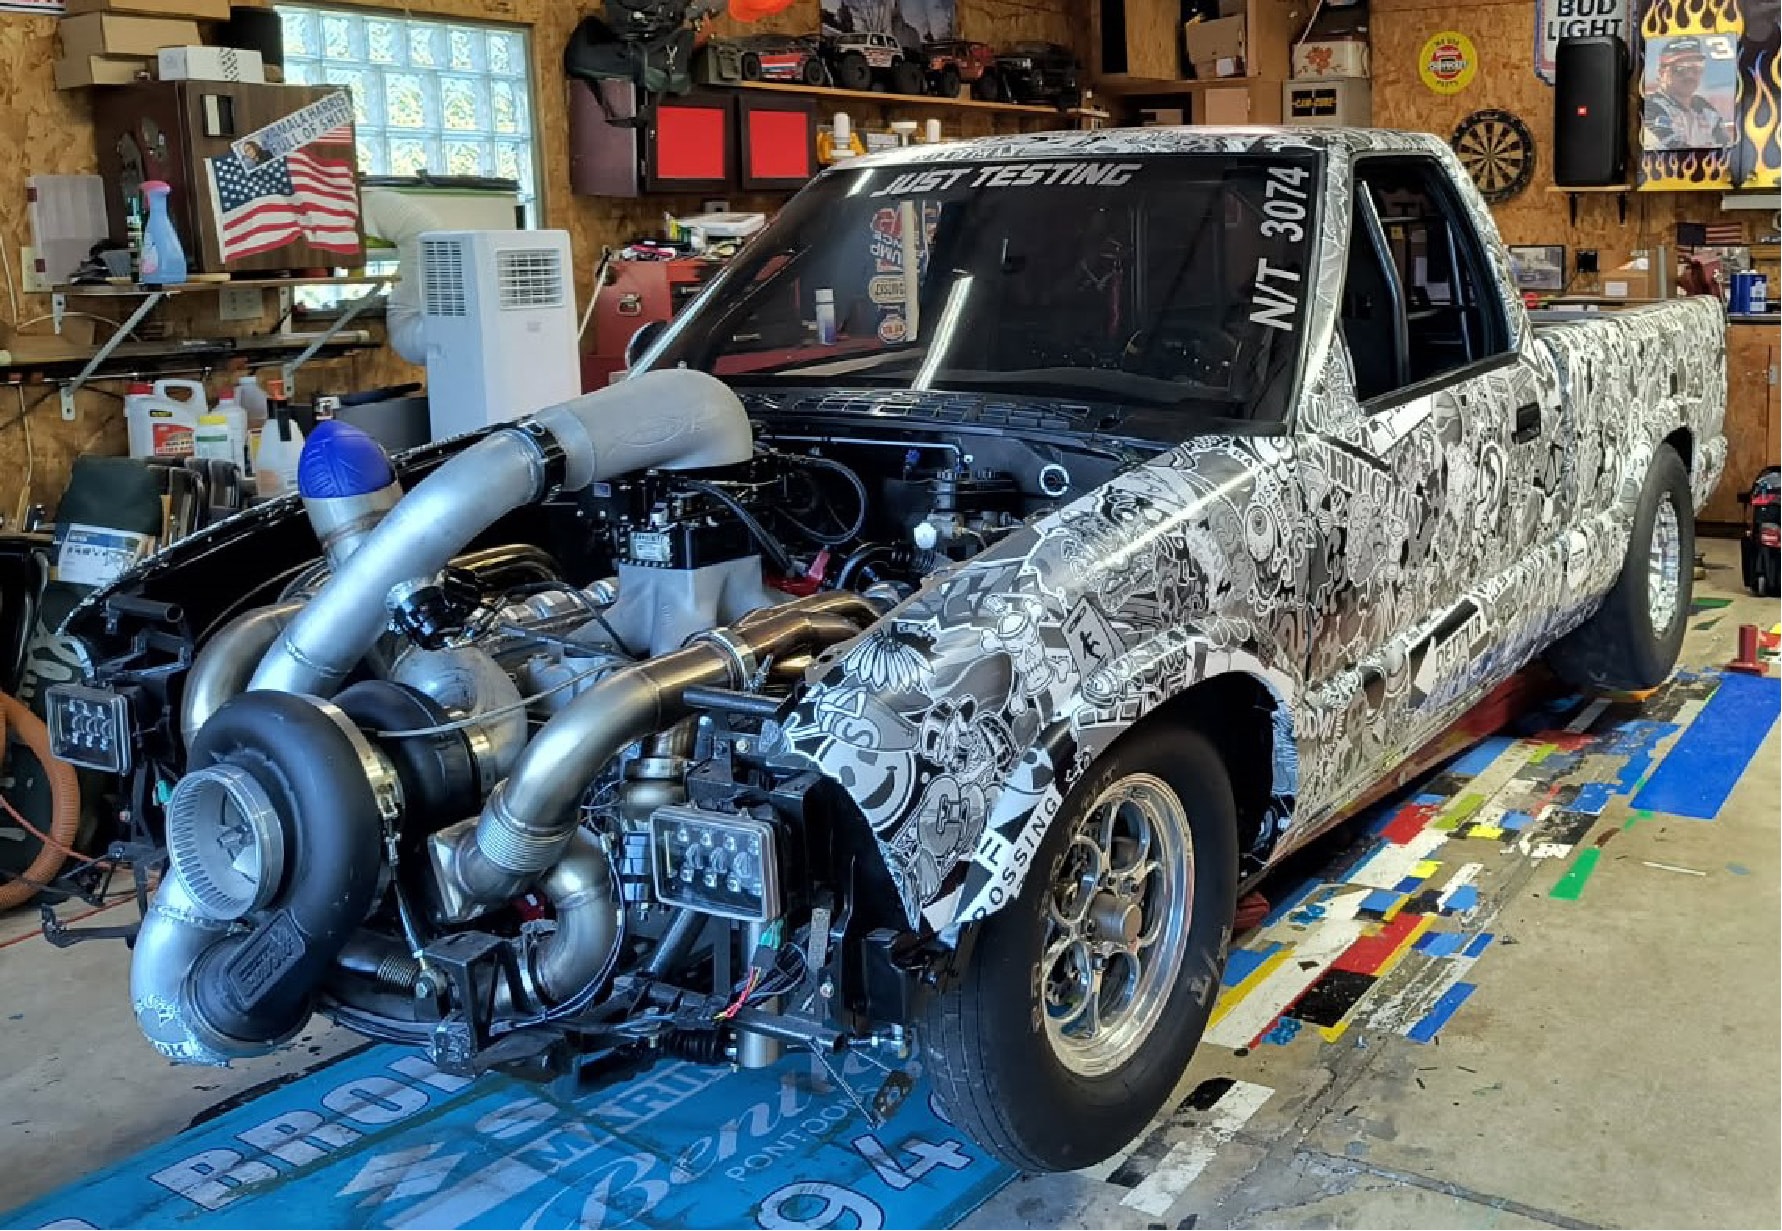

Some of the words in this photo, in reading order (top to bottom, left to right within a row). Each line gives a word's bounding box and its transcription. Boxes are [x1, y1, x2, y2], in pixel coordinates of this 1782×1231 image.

[1557, 0, 1617, 17] BUD
[1547, 19, 1623, 41] LIGHT
[1706, 36, 1735, 60] 3
[869, 168, 973, 198] JUST
[970, 163, 1142, 188] TESTING
[1260, 166, 1310, 243] 3074
[1249, 257, 1301, 331] N/T
